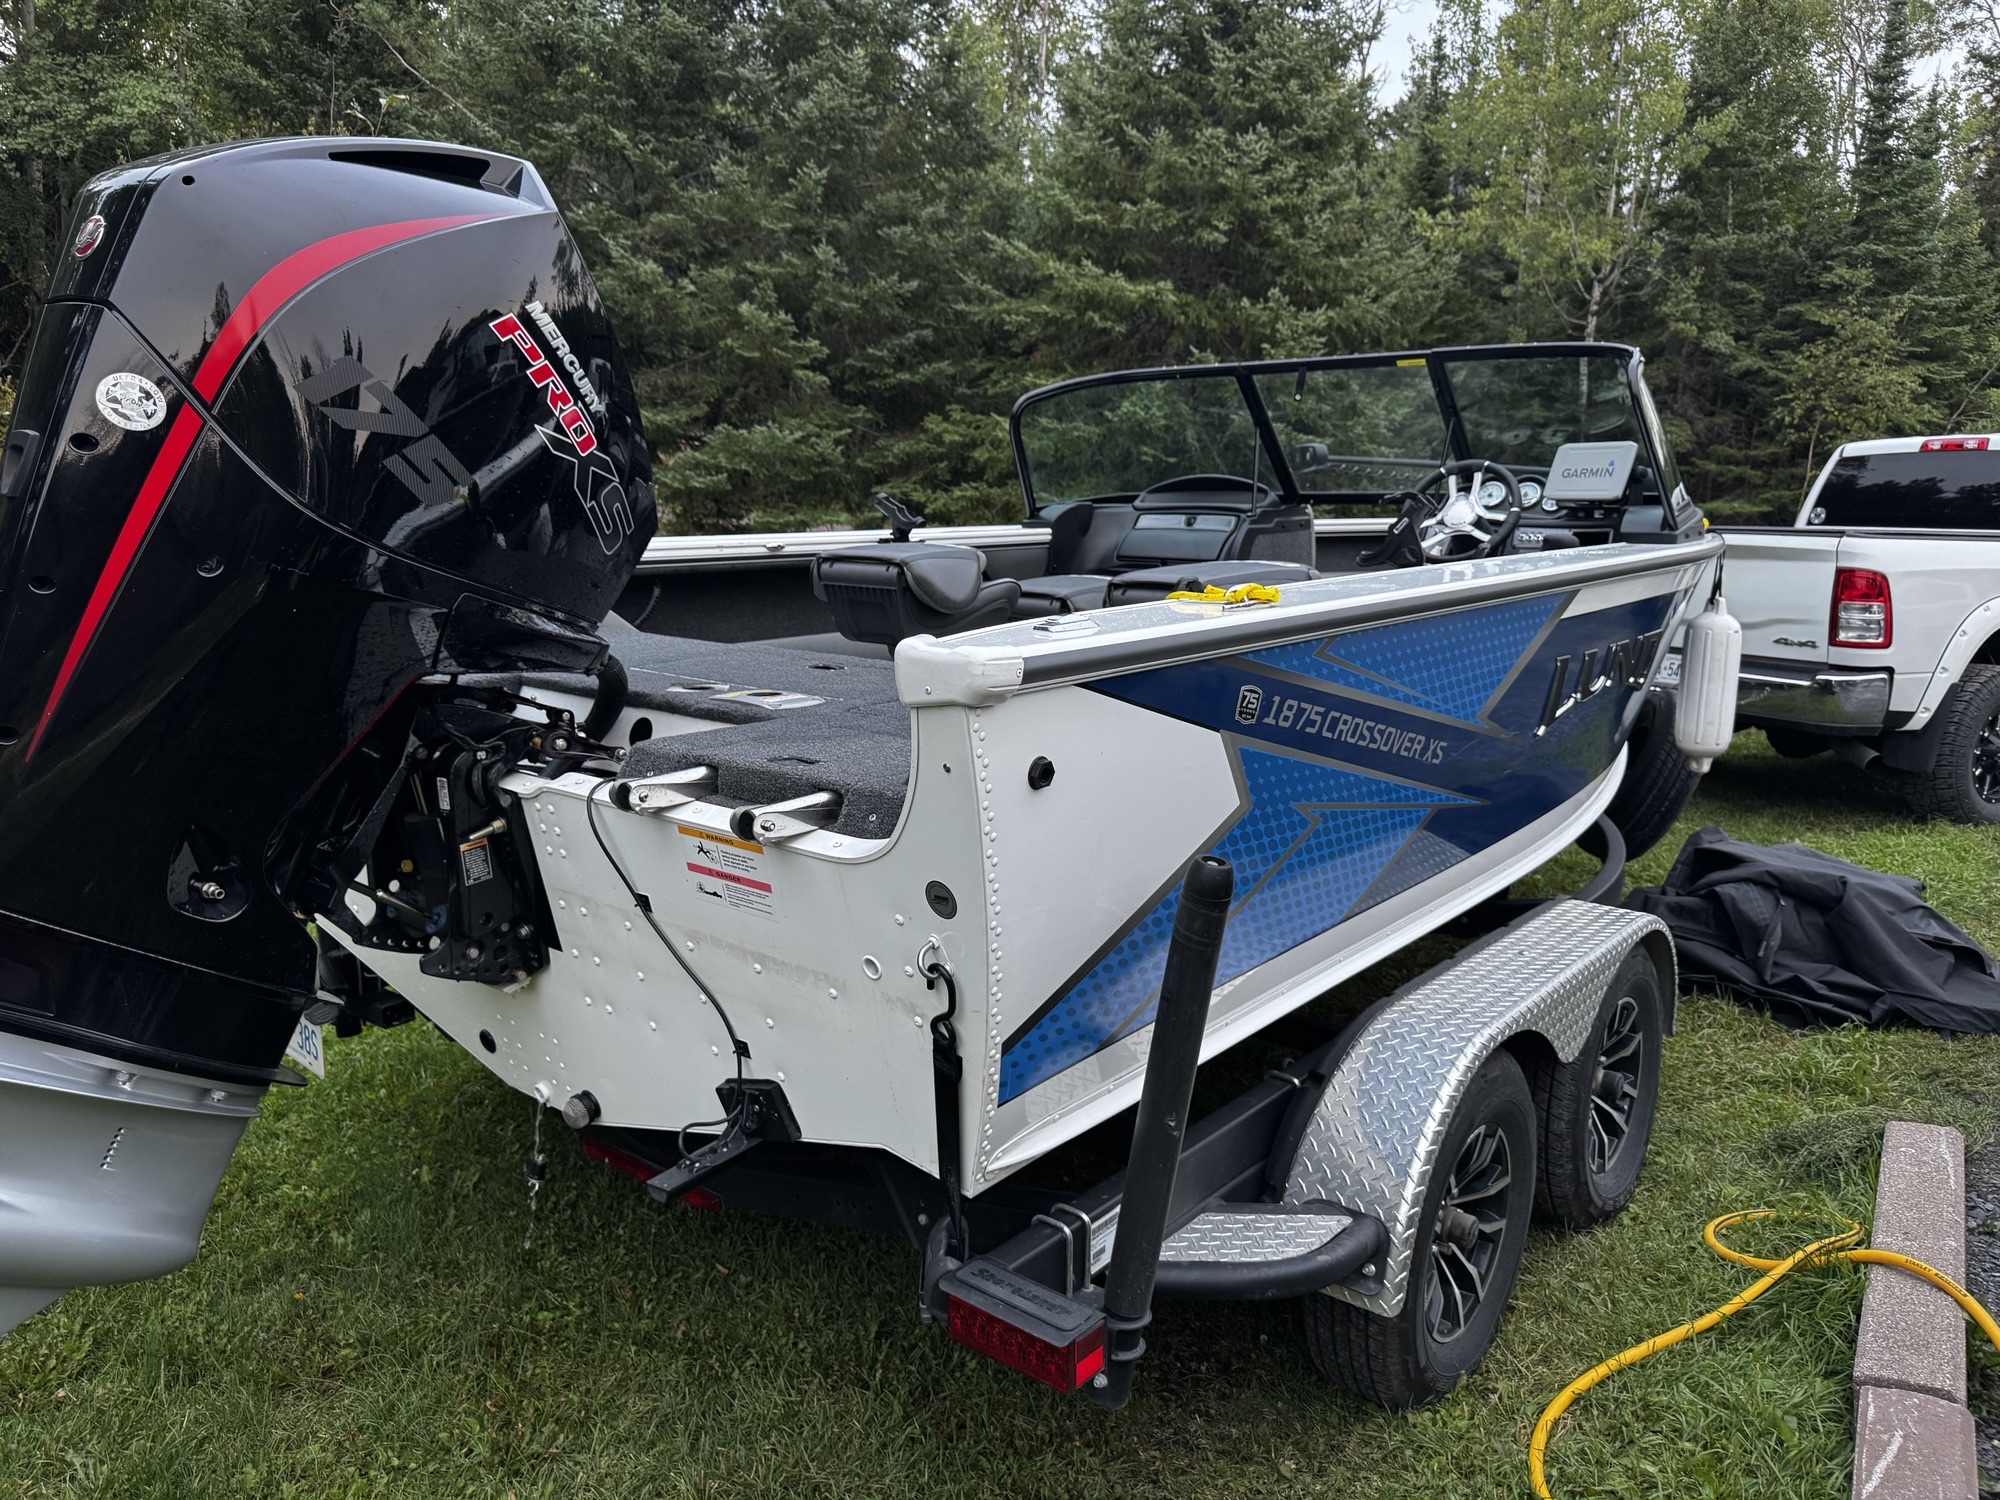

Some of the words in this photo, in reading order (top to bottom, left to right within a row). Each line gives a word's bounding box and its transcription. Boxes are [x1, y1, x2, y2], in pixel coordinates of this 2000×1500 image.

[525, 300, 602, 414] MERCURY
[112, 374, 143, 384] ULTRA
[148, 385, 164, 403] LOW
[489, 312, 597, 457] PRO
[293, 355, 475, 506] 175
[534, 401, 635, 555] XS
[1561, 467, 1615, 479] GARMIN
[1242, 691, 1259, 709] 75
[1262, 696, 1326, 734] 1875
[1322, 711, 1426, 759] CROSSOVER
[1423, 738, 1448, 764] XS
[705, 832, 734, 846] WARNING
[715, 871, 742, 883] DANGER
